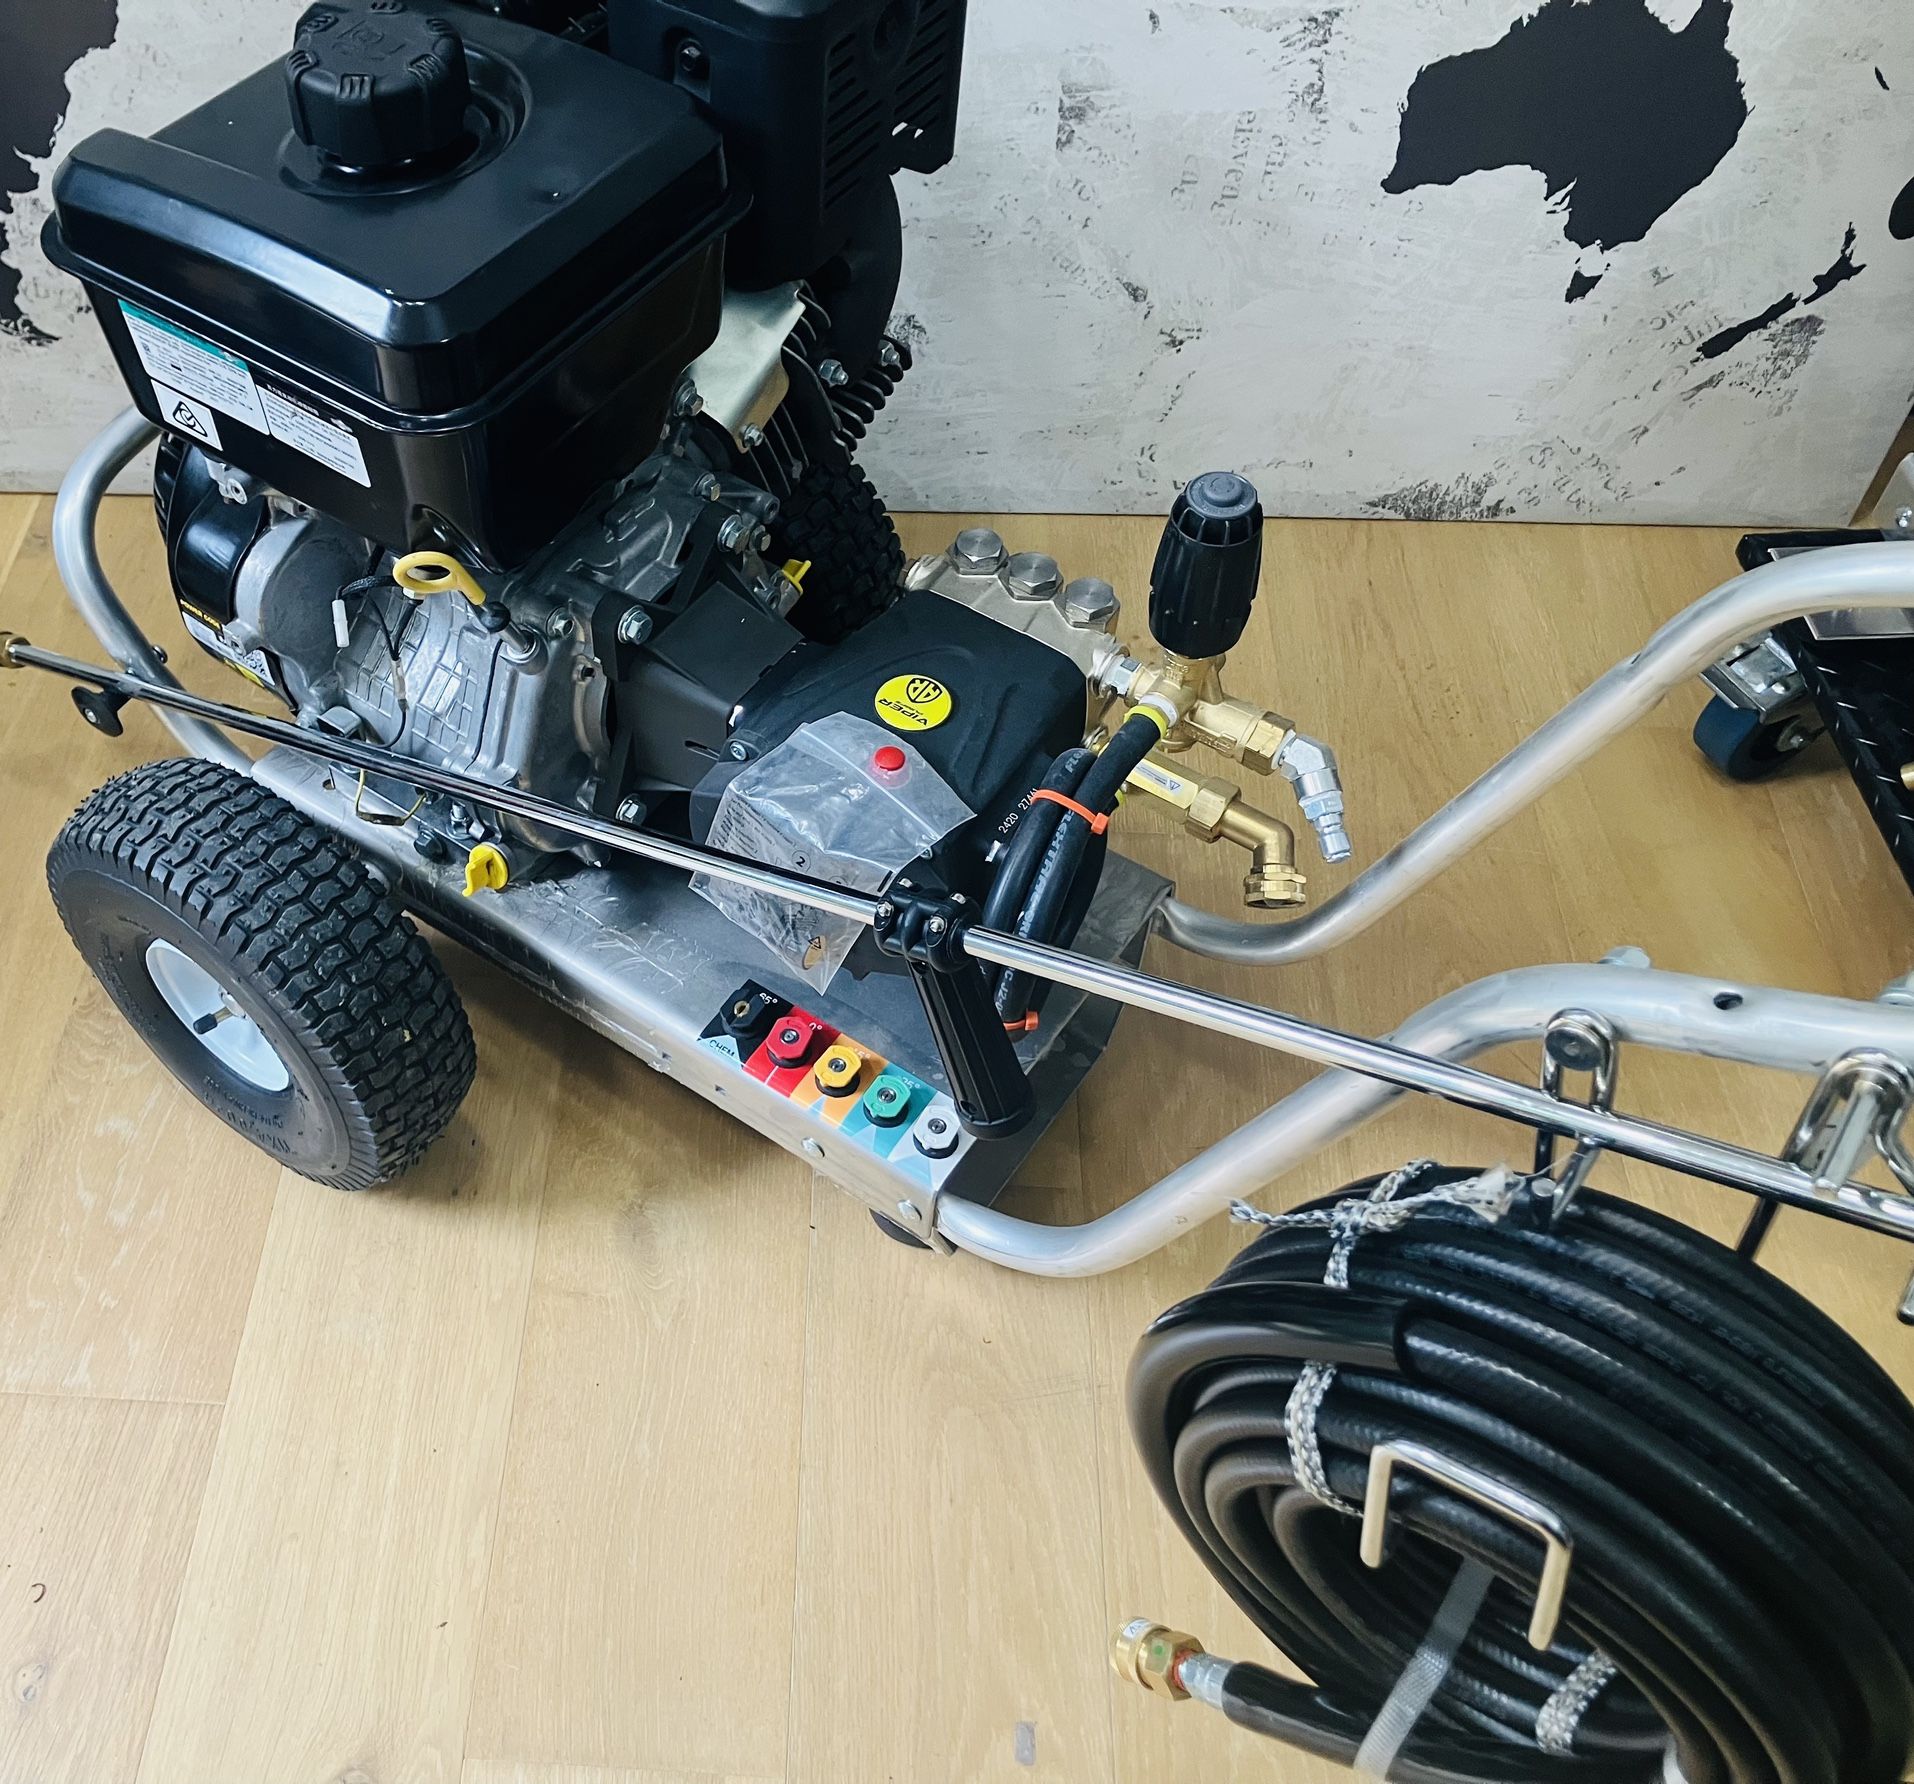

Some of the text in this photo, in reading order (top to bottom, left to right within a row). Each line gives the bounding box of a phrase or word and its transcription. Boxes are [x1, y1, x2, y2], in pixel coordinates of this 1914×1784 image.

[878, 698, 928, 726] VIPER
[998, 813, 1019, 834] 2420
[795, 856, 806, 867] 2
[708, 1039, 735, 1057] CHEM
